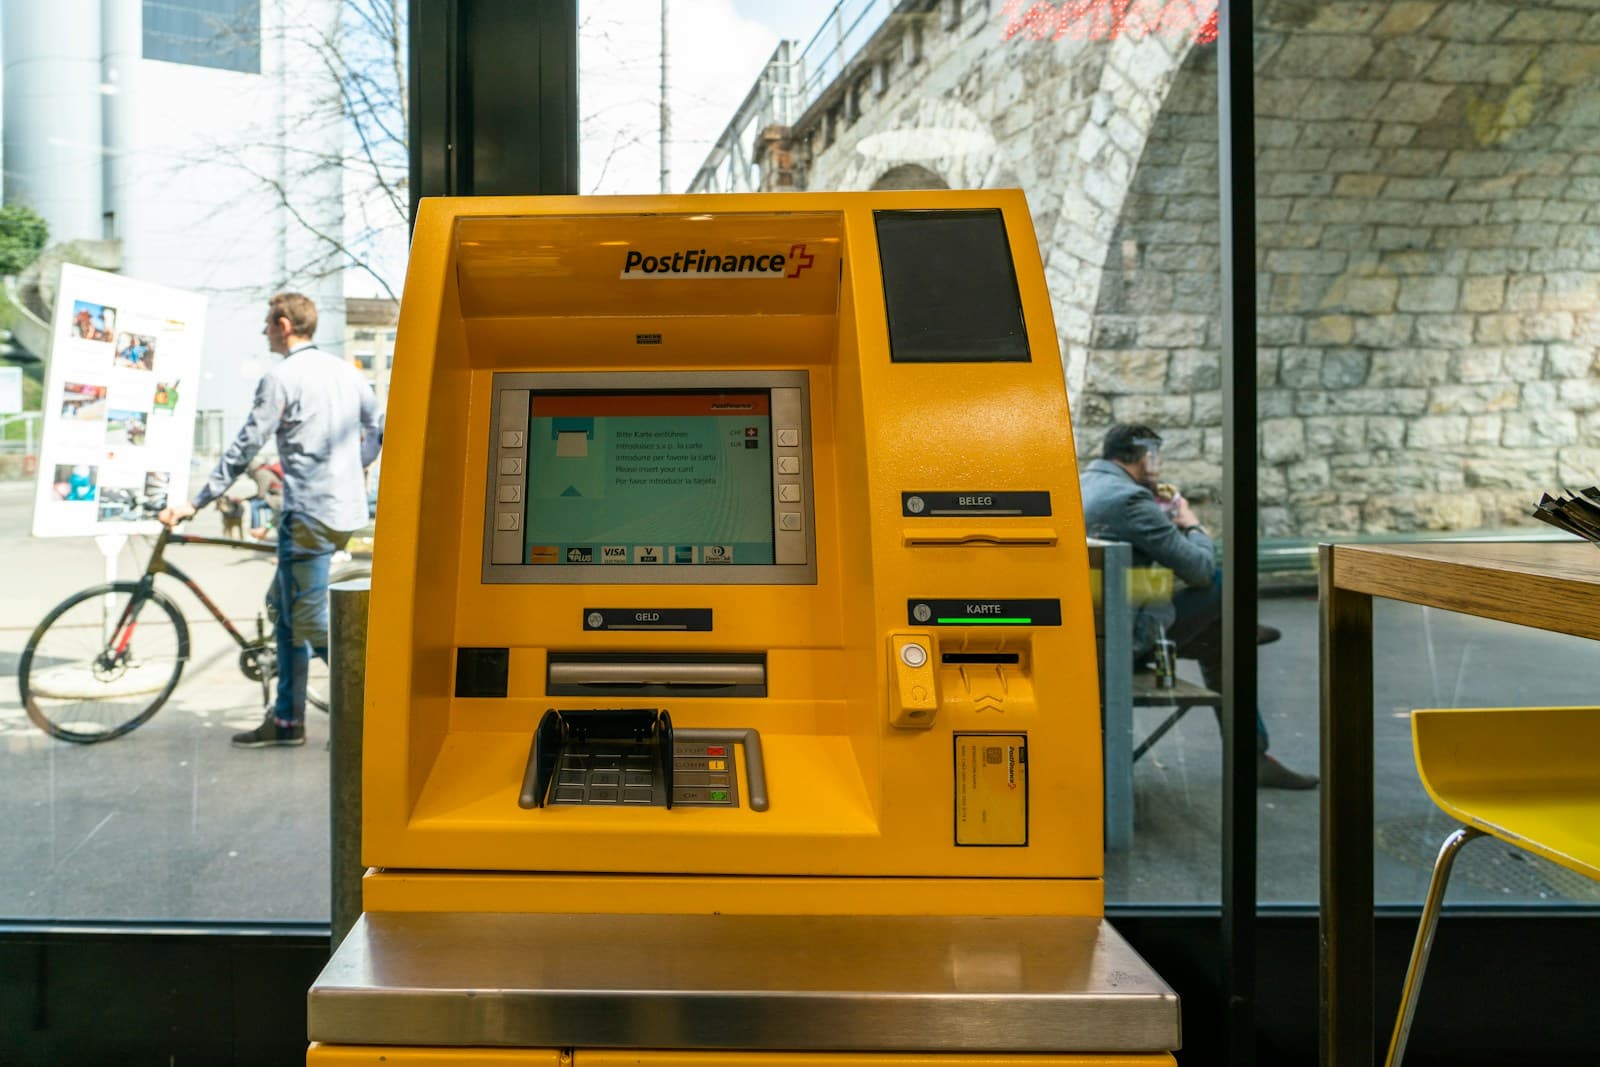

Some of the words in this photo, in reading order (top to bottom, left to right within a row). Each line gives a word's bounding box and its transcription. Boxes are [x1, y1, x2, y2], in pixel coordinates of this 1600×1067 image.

[624, 249, 786, 274] PostFinance
[958, 496, 992, 506] BELEG
[604, 548, 626, 556] VISA
[966, 604, 1001, 614] KARTE
[635, 612, 660, 622] GELD
